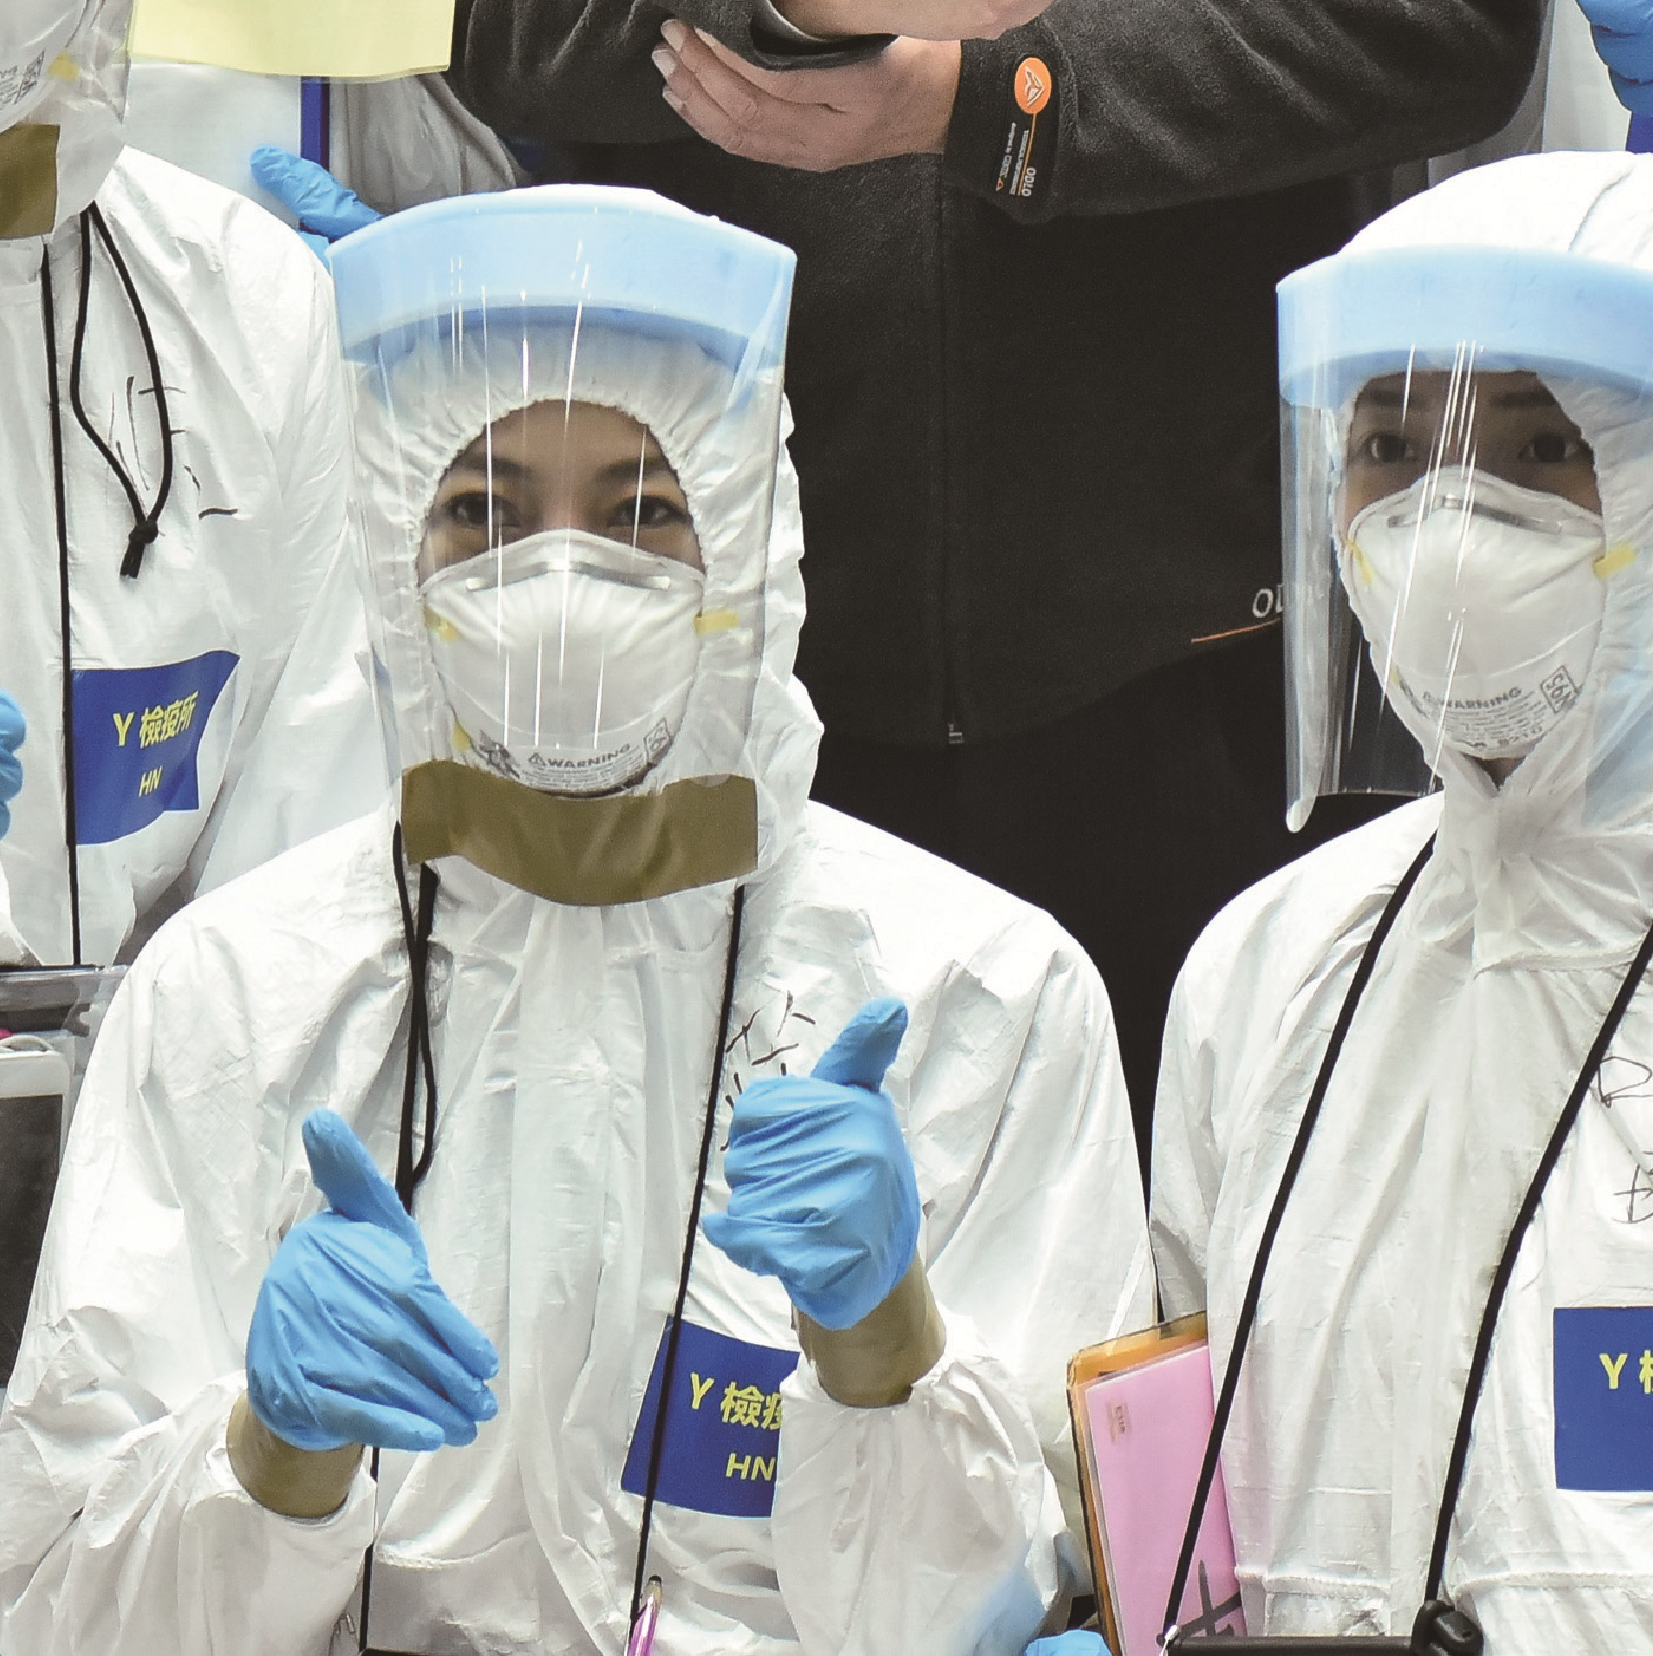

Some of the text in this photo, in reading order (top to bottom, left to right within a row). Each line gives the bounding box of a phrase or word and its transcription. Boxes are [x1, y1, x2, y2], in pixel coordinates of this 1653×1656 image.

[113, 691, 199, 749] Y 檢疫所
[138, 766, 163, 797] HN
[1598, 1353, 1629, 1390] Y
[689, 1372, 715, 1411] Y
[724, 1452, 777, 1482] HN
